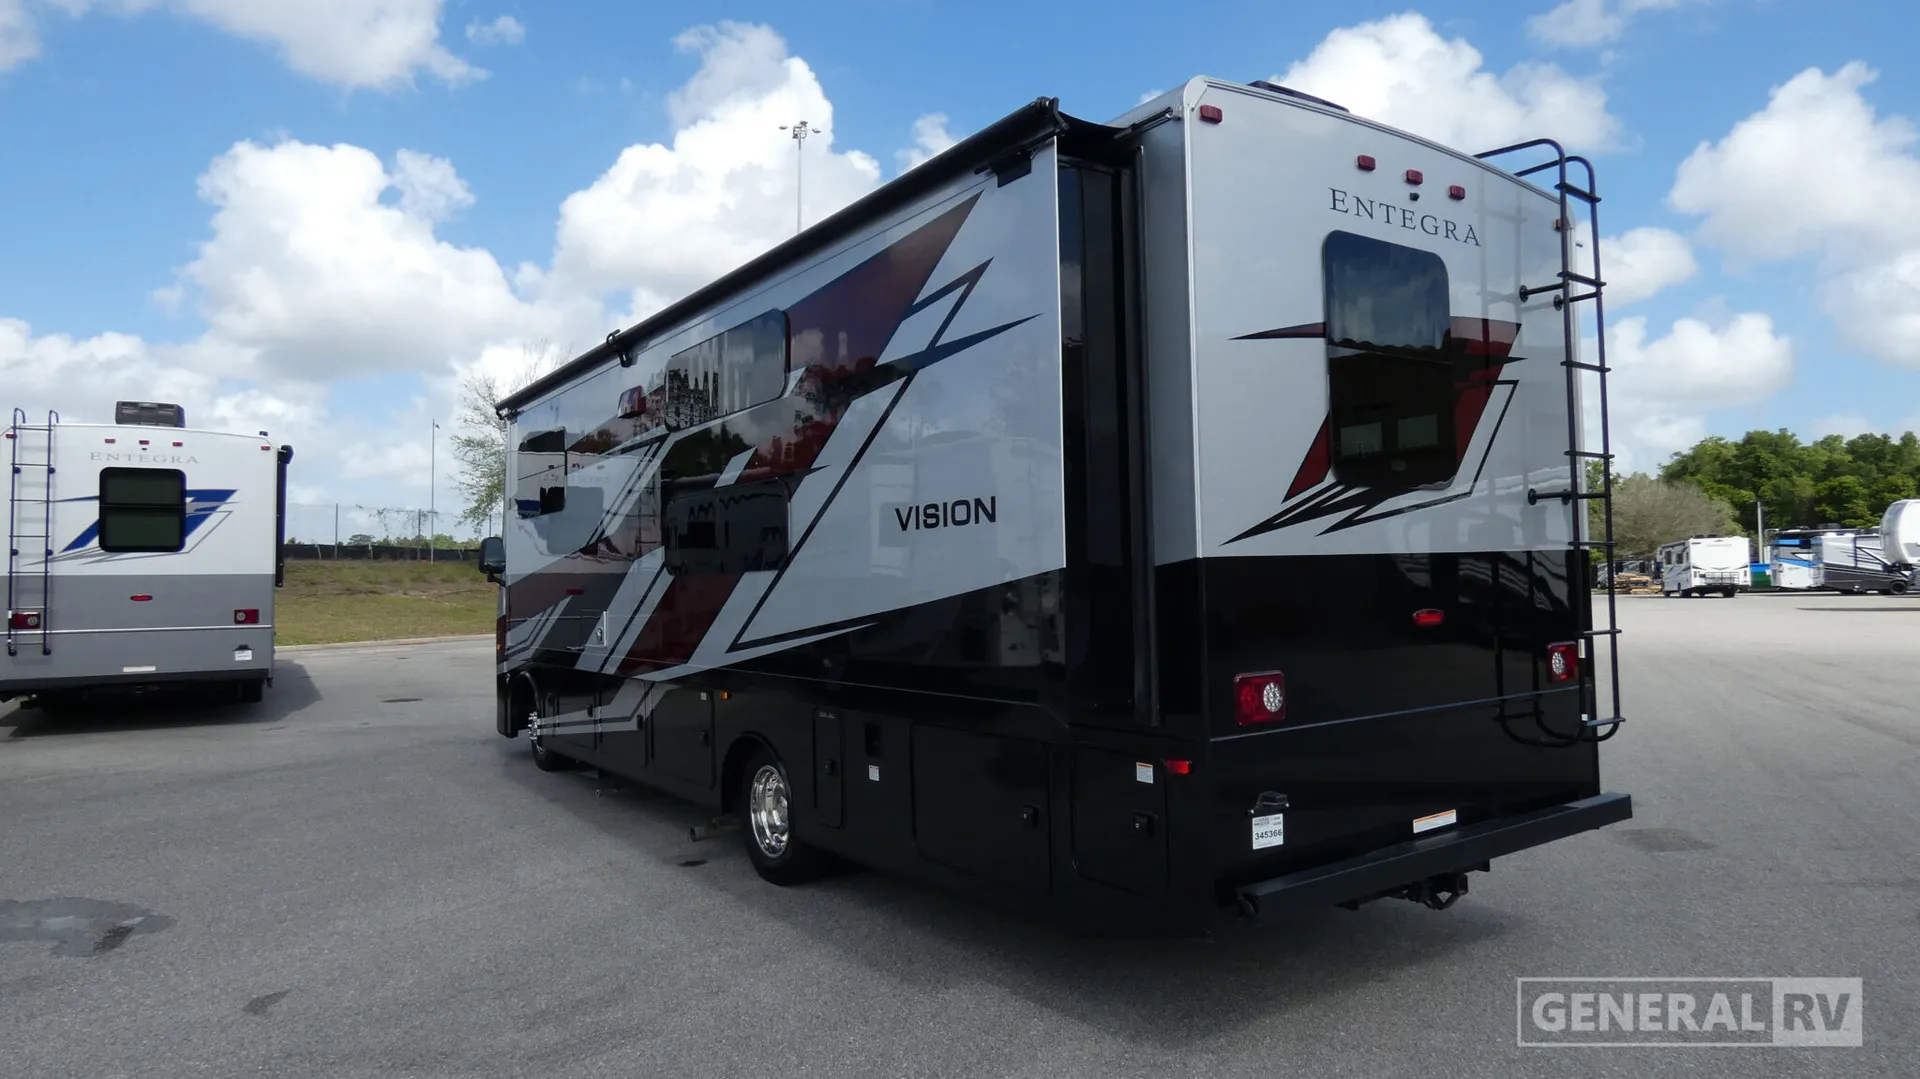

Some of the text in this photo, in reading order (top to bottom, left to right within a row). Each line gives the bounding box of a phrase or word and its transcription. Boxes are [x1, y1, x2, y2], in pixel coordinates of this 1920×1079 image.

[1328, 187, 1481, 247] ENTEGRA
[89, 452, 199, 465] ENTEGRA
[895, 495, 998, 531] VISION
[1254, 828, 1283, 841] 345366
